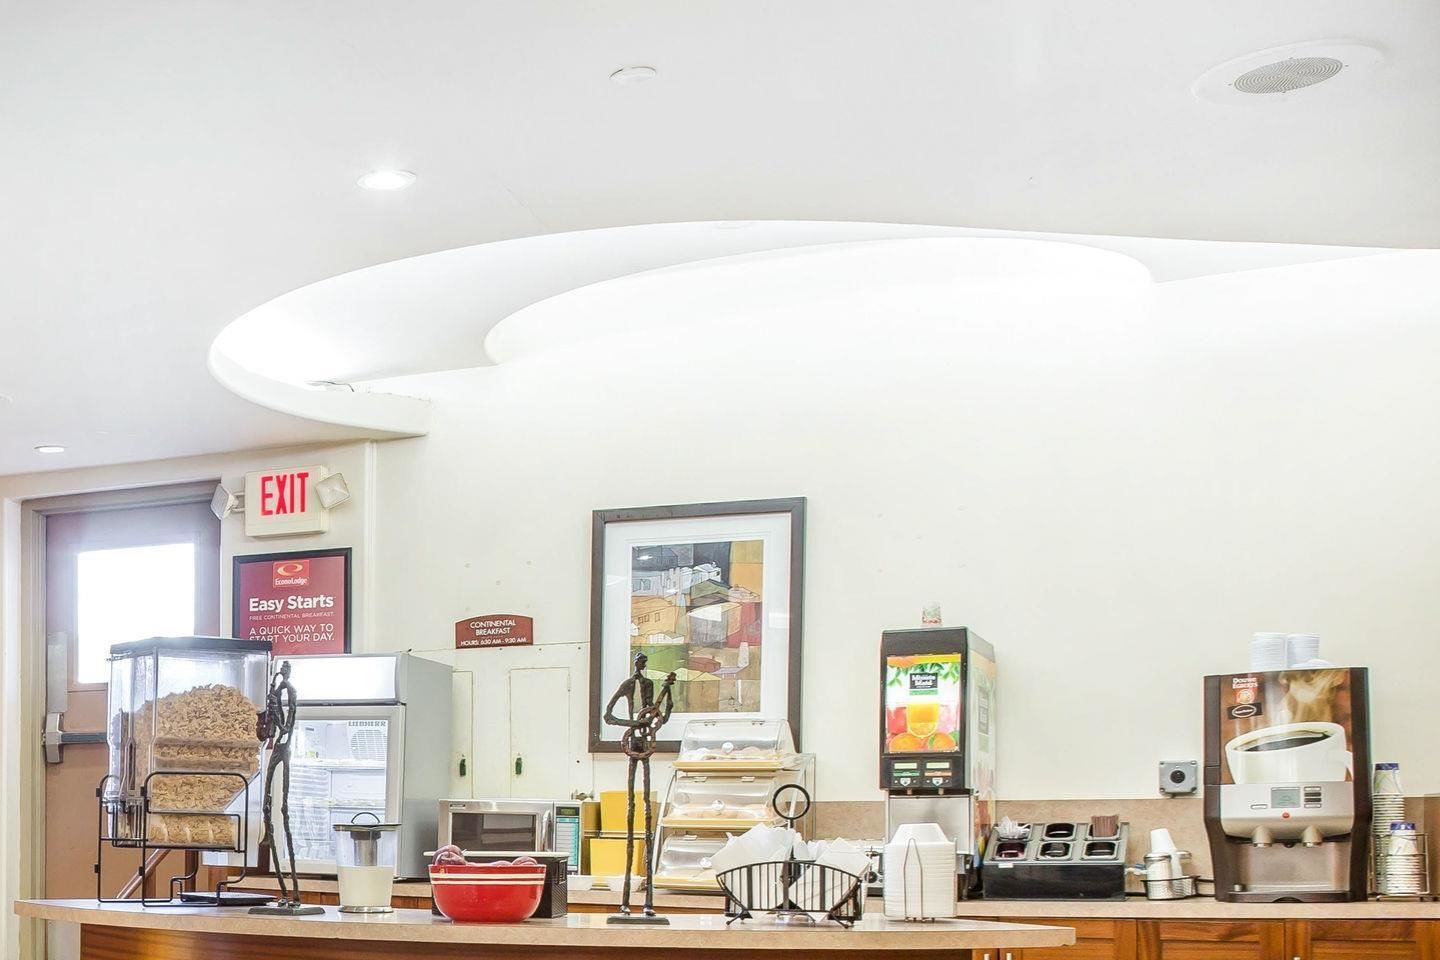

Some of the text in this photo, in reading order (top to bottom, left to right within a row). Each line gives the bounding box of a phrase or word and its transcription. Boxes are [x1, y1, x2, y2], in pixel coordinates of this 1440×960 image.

[260, 472, 309, 516] EXIT
[249, 595, 334, 613] Easy Starts
[249, 623, 334, 636] A QUICK WAY TO
[470, 620, 516, 629] CONTINENTAL
[283, 634, 310, 643] YOUR
[313, 632, 335, 641] DAY.
[475, 628, 511, 636] BREAKFAST
